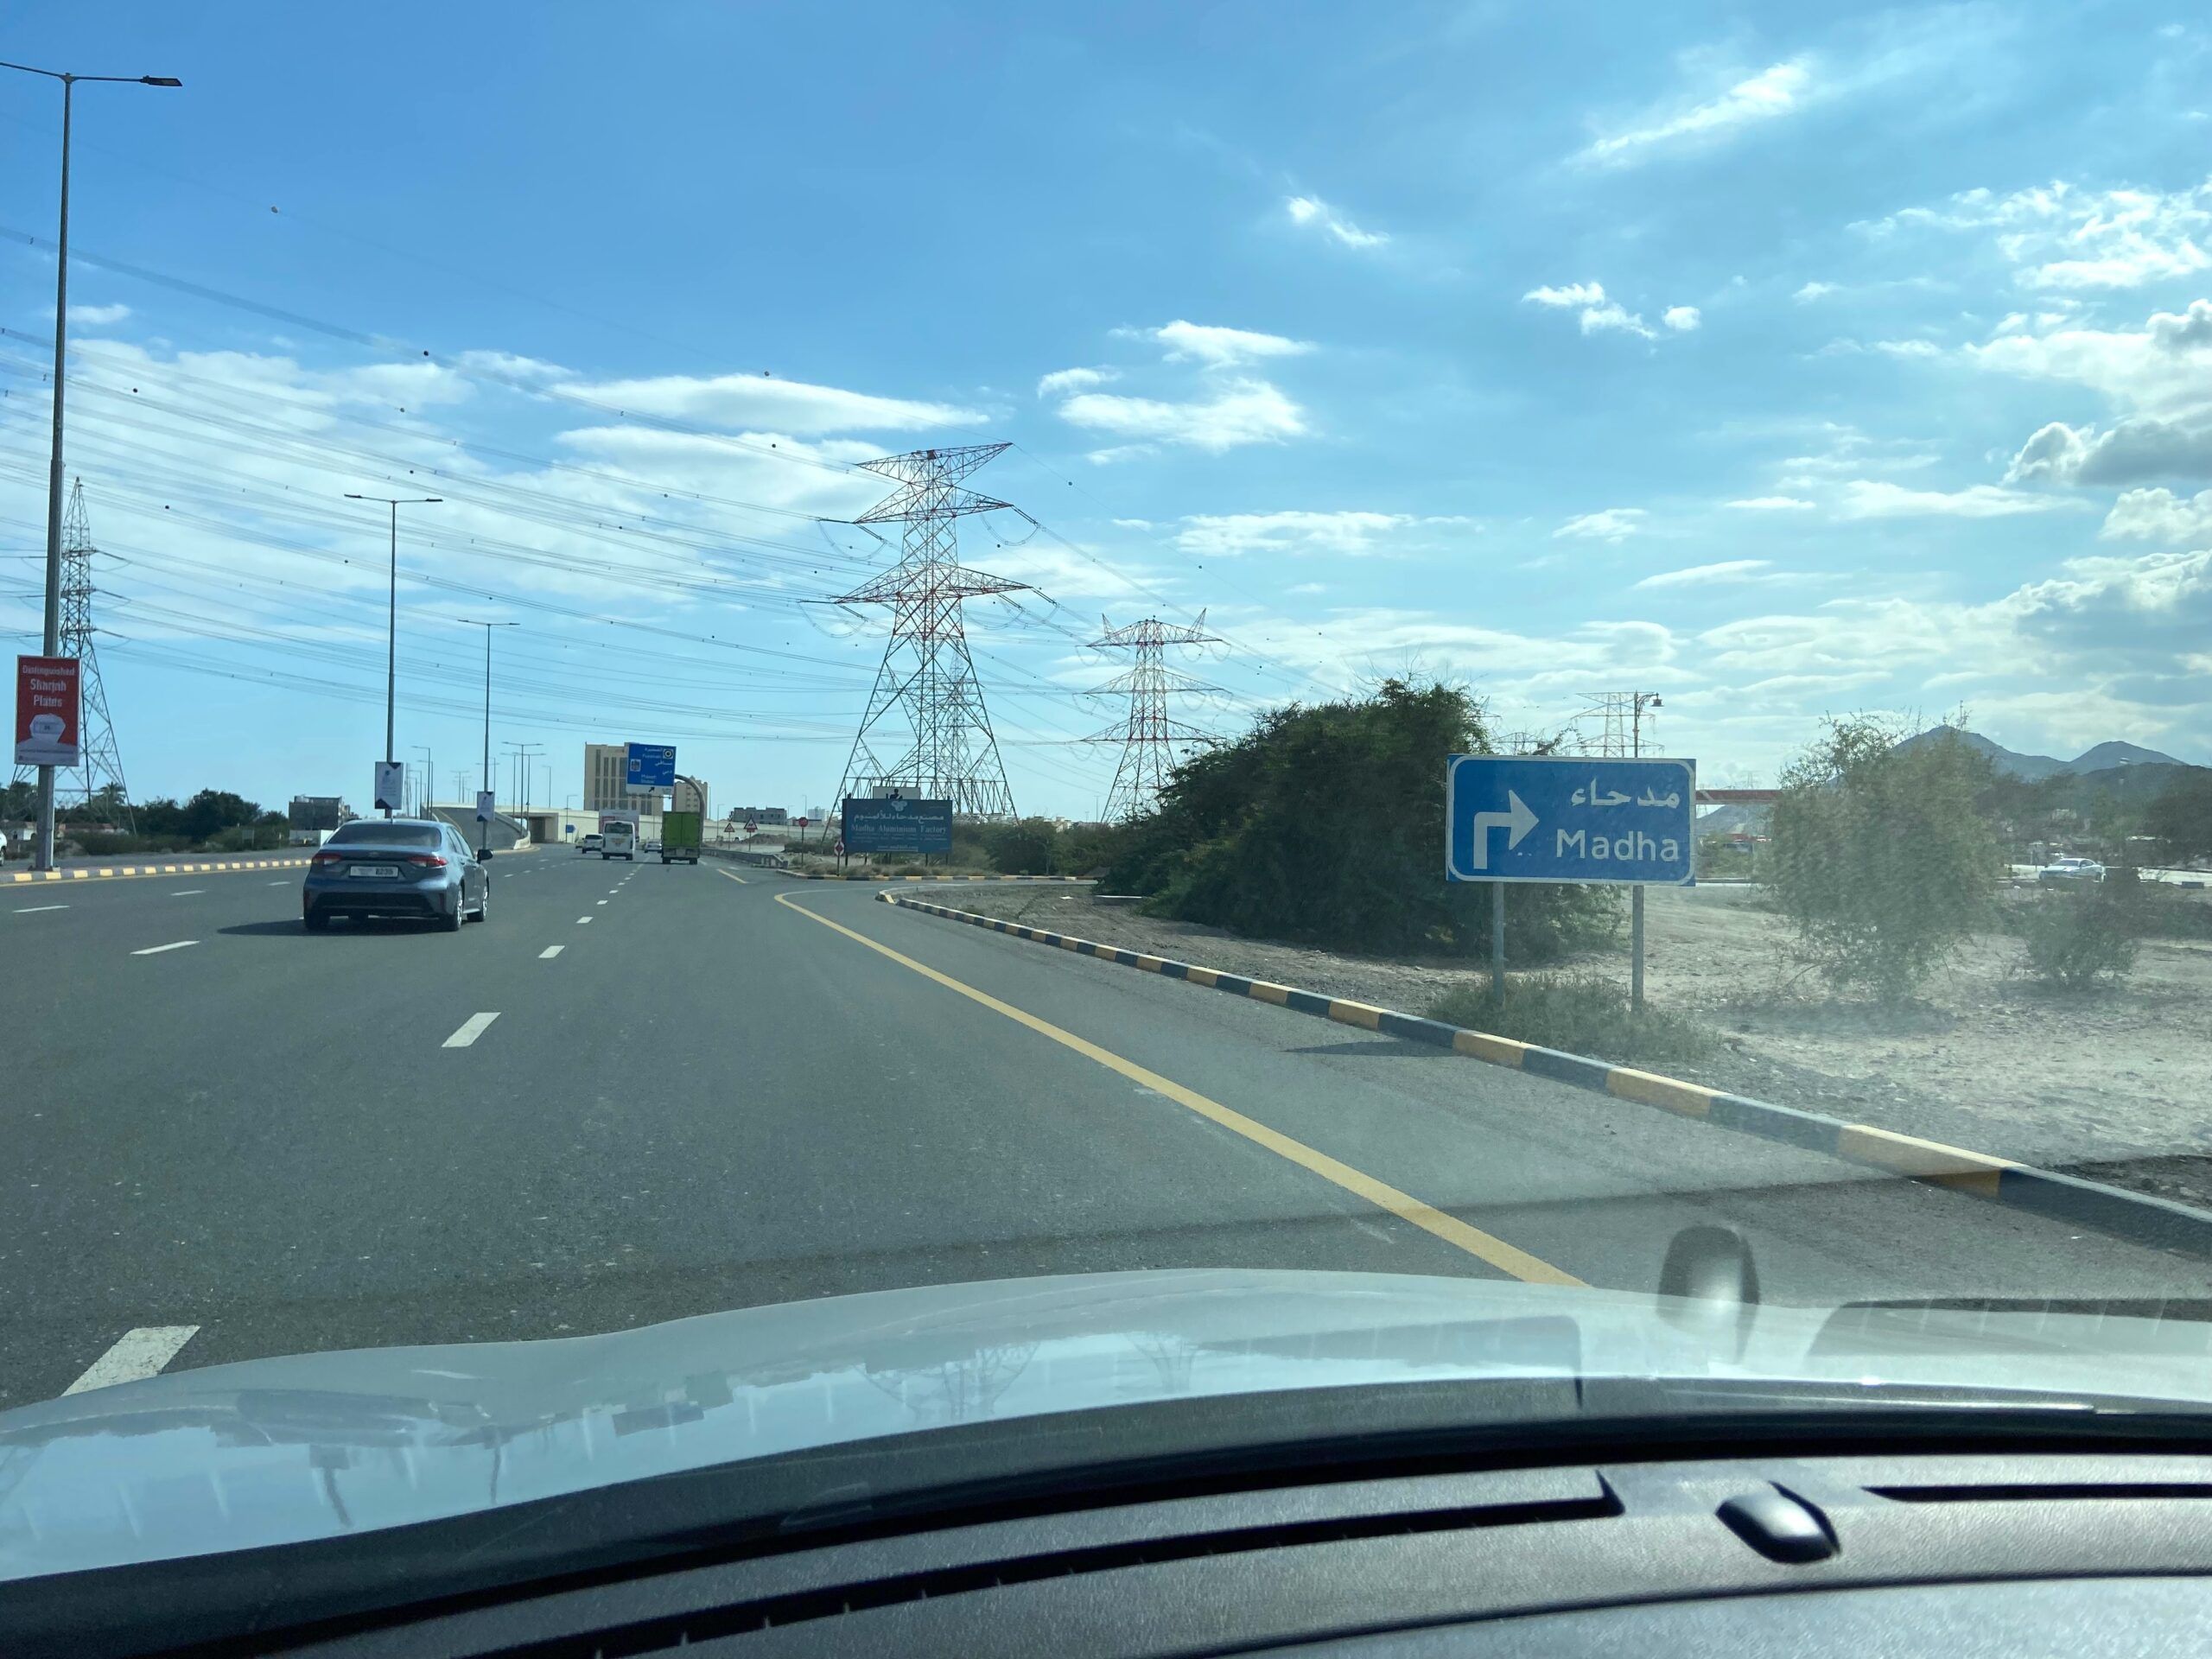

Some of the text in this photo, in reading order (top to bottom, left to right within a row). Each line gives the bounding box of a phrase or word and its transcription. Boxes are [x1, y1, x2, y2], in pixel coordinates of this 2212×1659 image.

[30, 678, 67, 693] Sharjah
[34, 694, 63, 707] Plates
[1571, 778, 1681, 809] مدحاء
[1556, 829, 1680, 862] Madha
